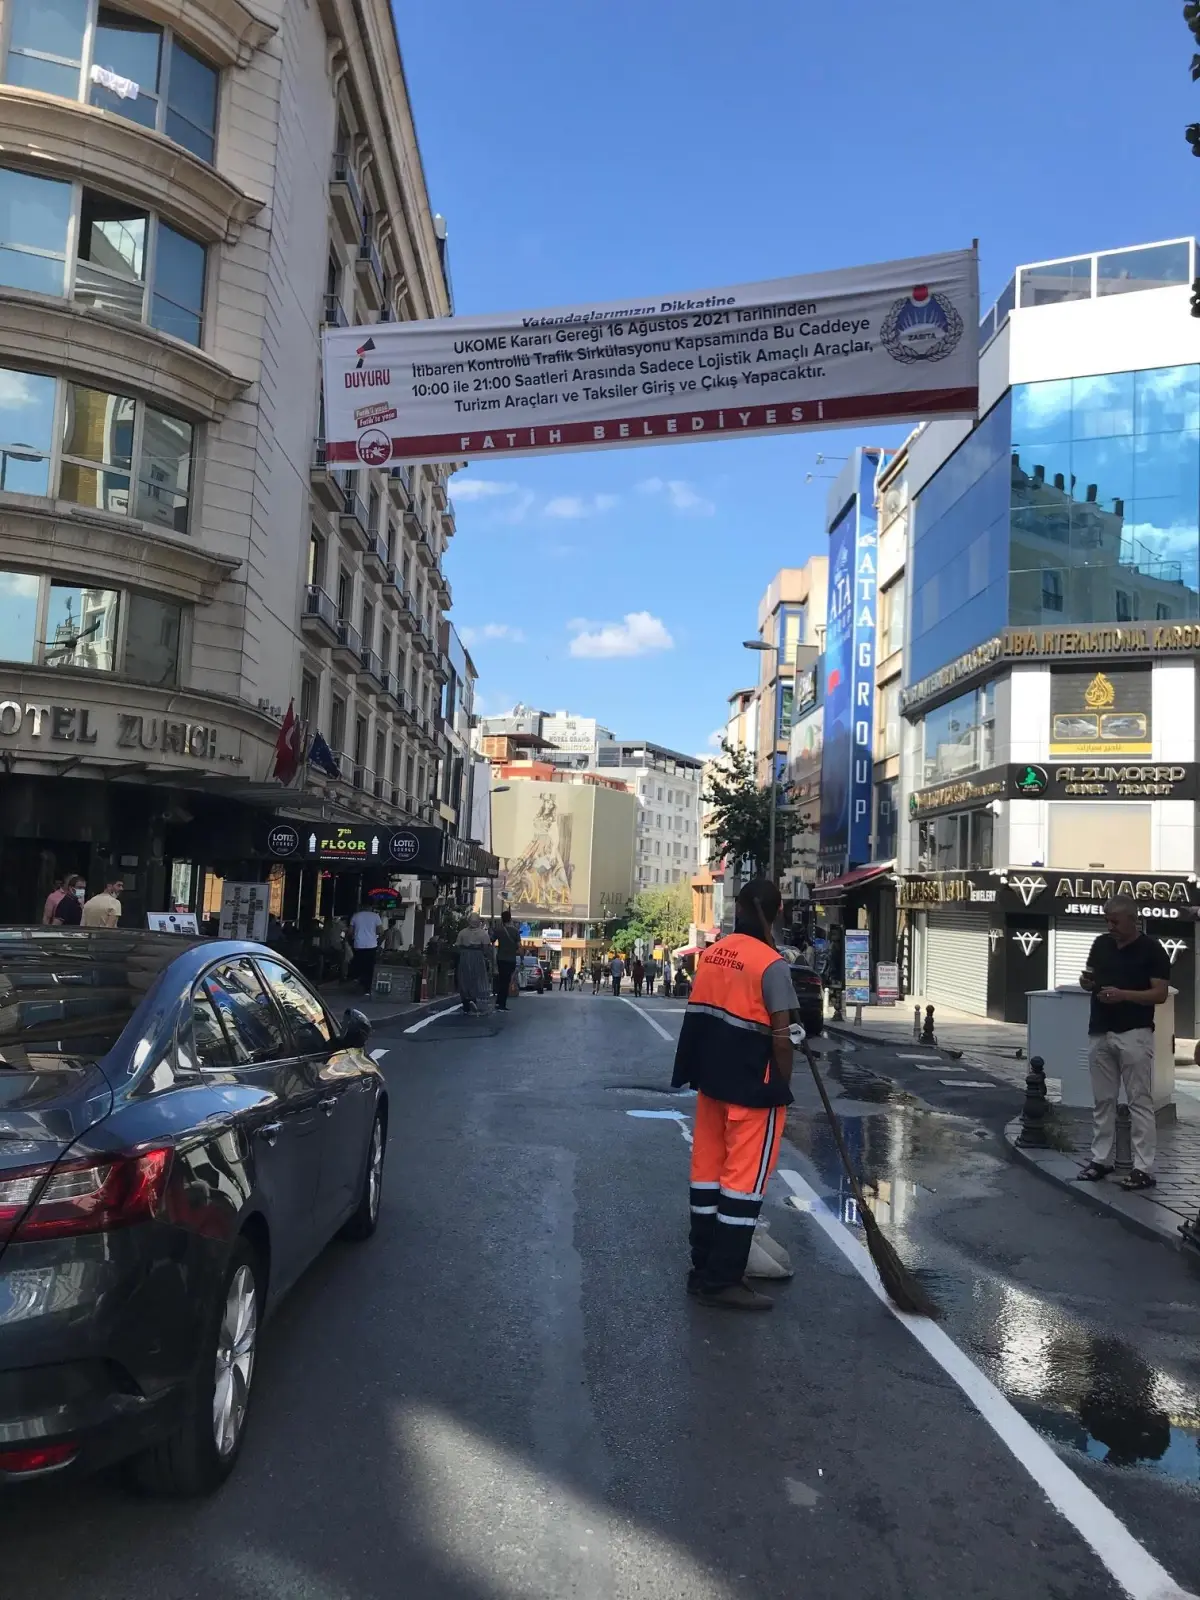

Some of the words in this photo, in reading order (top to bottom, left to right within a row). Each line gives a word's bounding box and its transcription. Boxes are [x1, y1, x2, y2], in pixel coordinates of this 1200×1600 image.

[454, 336, 507, 354] UKOME
[511, 333, 552, 348] Kararı
[555, 325, 603, 343] Gereği
[607, 322, 624, 337] 16
[628, 318, 689, 337] Ağustos
[692, 311, 731, 328] 2021
[735, 302, 817, 323] Tarihinden
[522, 306, 656, 329] Vatandaşlarımızın
[660, 296, 736, 313] Dikkatine
[412, 362, 464, 378] İtibaren
[467, 353, 530, 372] Kontrollü
[533, 349, 574, 365] Trafik
[576, 340, 671, 361] Sirkülasyonu
[675, 328, 769, 351] Kapsamında
[773, 325, 795, 339] Bu
[799, 319, 870, 336] Caddeye
[344, 369, 390, 388] DUYURU
[412, 382, 449, 397] 10:00
[453, 381, 469, 393] ile
[473, 376, 511, 391] 21:00
[515, 369, 568, 387] Saatleri
[572, 363, 636, 381] Arasında
[640, 359, 694, 375] Sadece
[698, 351, 752, 370] Lojistik
[756, 344, 808, 362] Amaçlı
[813, 340, 874, 356] Araçlar,
[454, 398, 501, 412] Turizm
[504, 393, 558, 408] Araçları
[562, 391, 579, 402] ve
[583, 384, 638, 401] Taksiler
[642, 380, 676, 396] Giriş
[679, 380, 697, 391] ve
[701, 374, 738, 391] Çıkış
[742, 366, 826, 386] Yapacaktır.
[461, 429, 561, 450] FATİH
[594, 402, 824, 440] BELEDİYESİ
[1055, 766, 1186, 782] ALZUMORRD
[321, 840, 366, 850] FLOOR
[1055, 878, 1190, 903] ALMASSA
